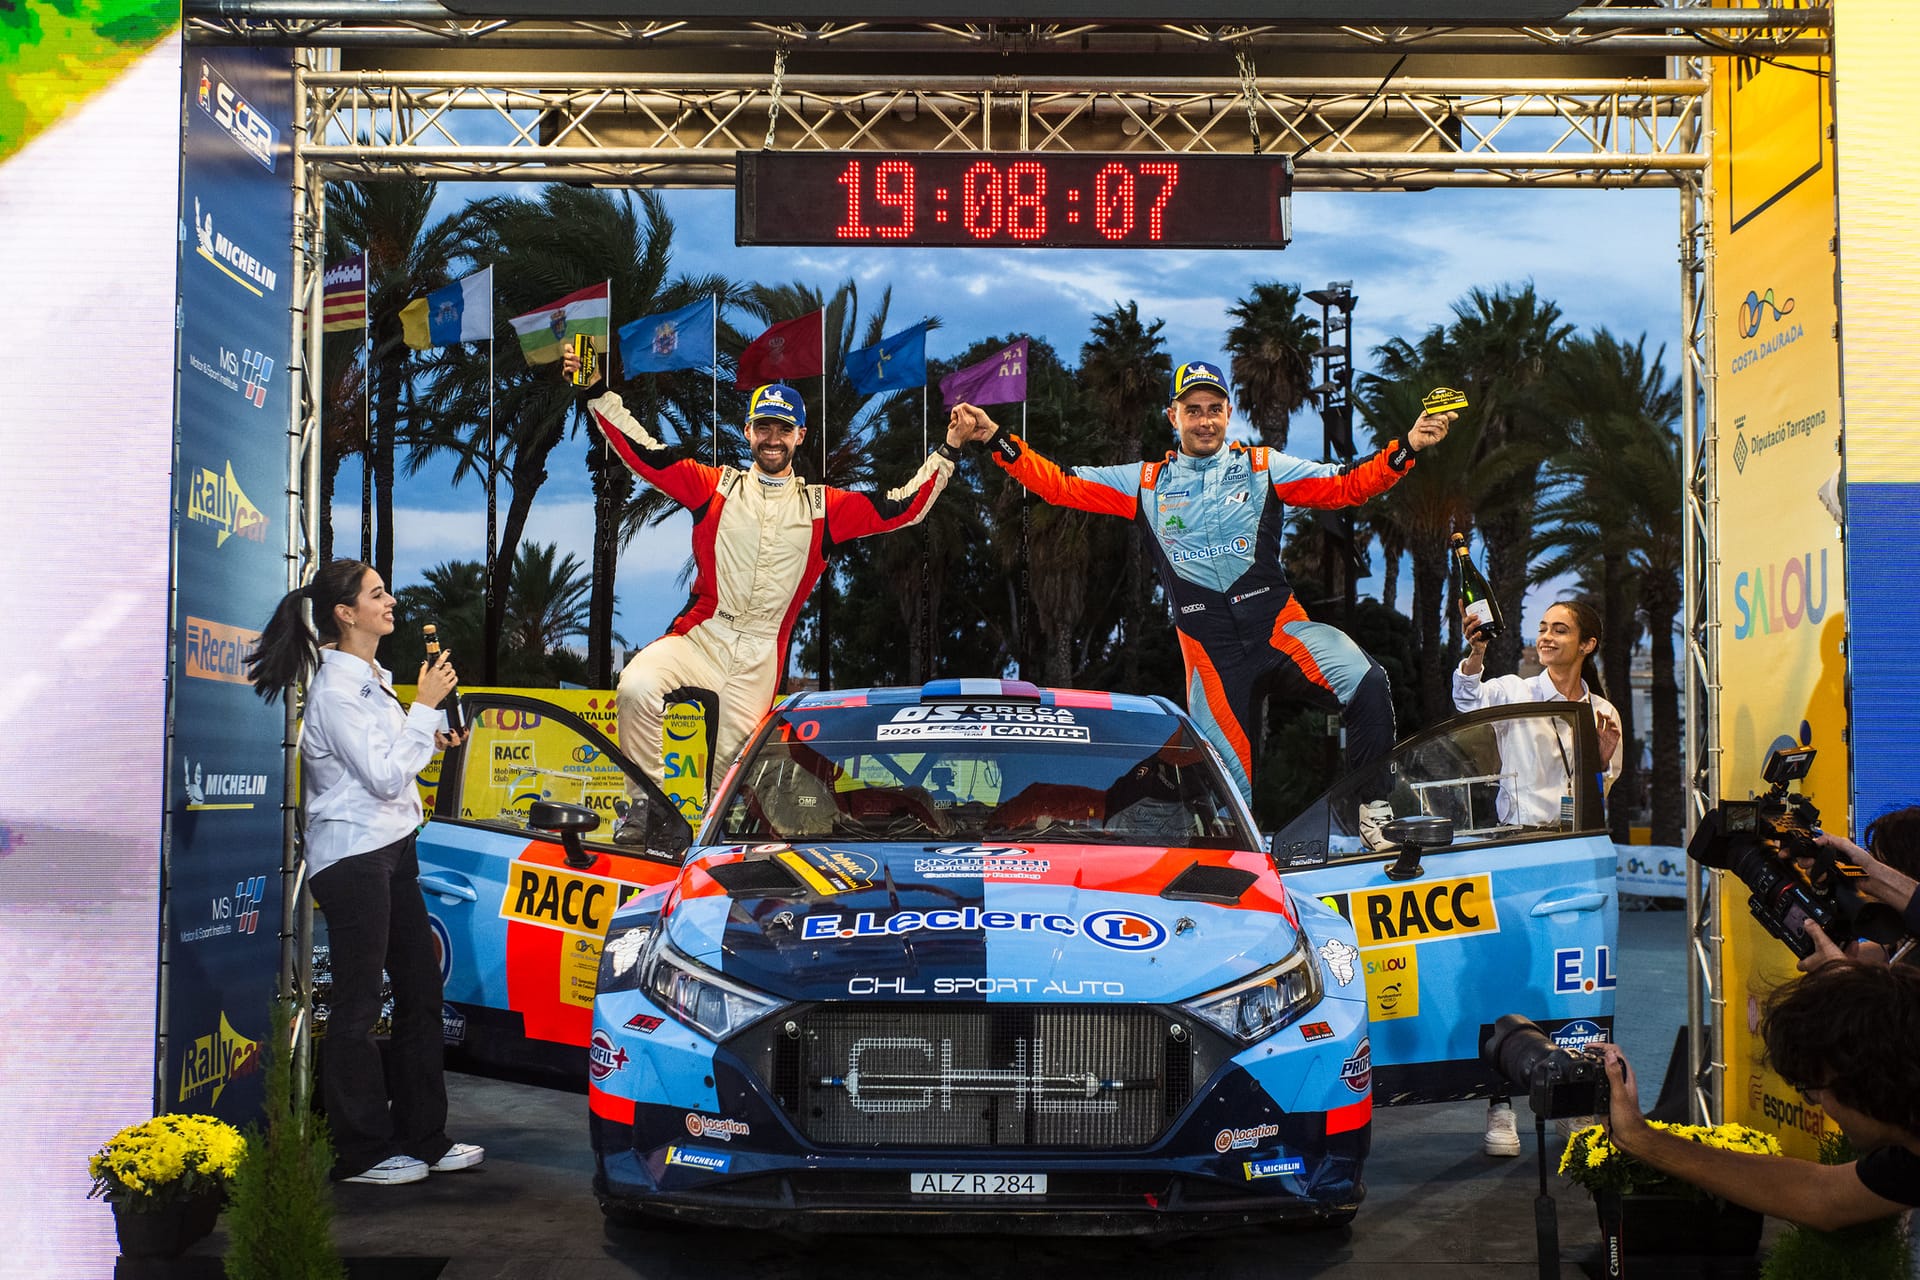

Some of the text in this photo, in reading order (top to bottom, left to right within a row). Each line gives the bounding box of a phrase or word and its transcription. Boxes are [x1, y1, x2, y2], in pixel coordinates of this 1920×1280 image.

[835, 160, 1179, 240] 19:08:07
[215, 233, 277, 291] MICHELIN
[1731, 323, 1803, 374] COSTA DAURADA
[1751, 410, 1826, 455] Diputació Tarragona
[191, 465, 270, 544] Rallycar
[1173, 545, 1231, 563] E.Leclerc
[1734, 548, 1827, 640] SALOU
[200, 628, 253, 676] Recalv
[973, 706, 1074, 716] ORECA
[980, 714, 1075, 724] STORE
[777, 720, 820, 743] 10
[879, 727, 921, 736] 2026
[994, 726, 1084, 739] CANAL+
[495, 746, 530, 760] RACC
[494, 767, 522, 775] Mobility
[563, 765, 592, 773] COSTA
[205, 773, 268, 797] MICHELIN
[494, 775, 509, 783] Club
[799, 798, 818, 807] OMP
[915, 859, 1050, 867] HYUNDAI
[515, 870, 605, 929] RACC
[1367, 882, 1480, 941] RACC
[801, 906, 1078, 940] E.Leclerc
[1367, 957, 1406, 974] SALOU
[849, 978, 1124, 995] CHL SPORT AUTO
[630, 1015, 659, 1029] ETS
[1302, 1022, 1332, 1036] ETS
[1555, 1032, 1607, 1045] TROPHÉE
[1763, 1094, 1824, 1137] esportcat
[702, 1115, 750, 1135] Location
[1234, 1124, 1279, 1140] Location
[683, 1154, 725, 1167] MICHELIN
[1263, 1162, 1300, 1173] MICHELIN
[921, 1174, 1035, 1193] ALZ R 284
[1609, 1236, 1619, 1277] Canon
